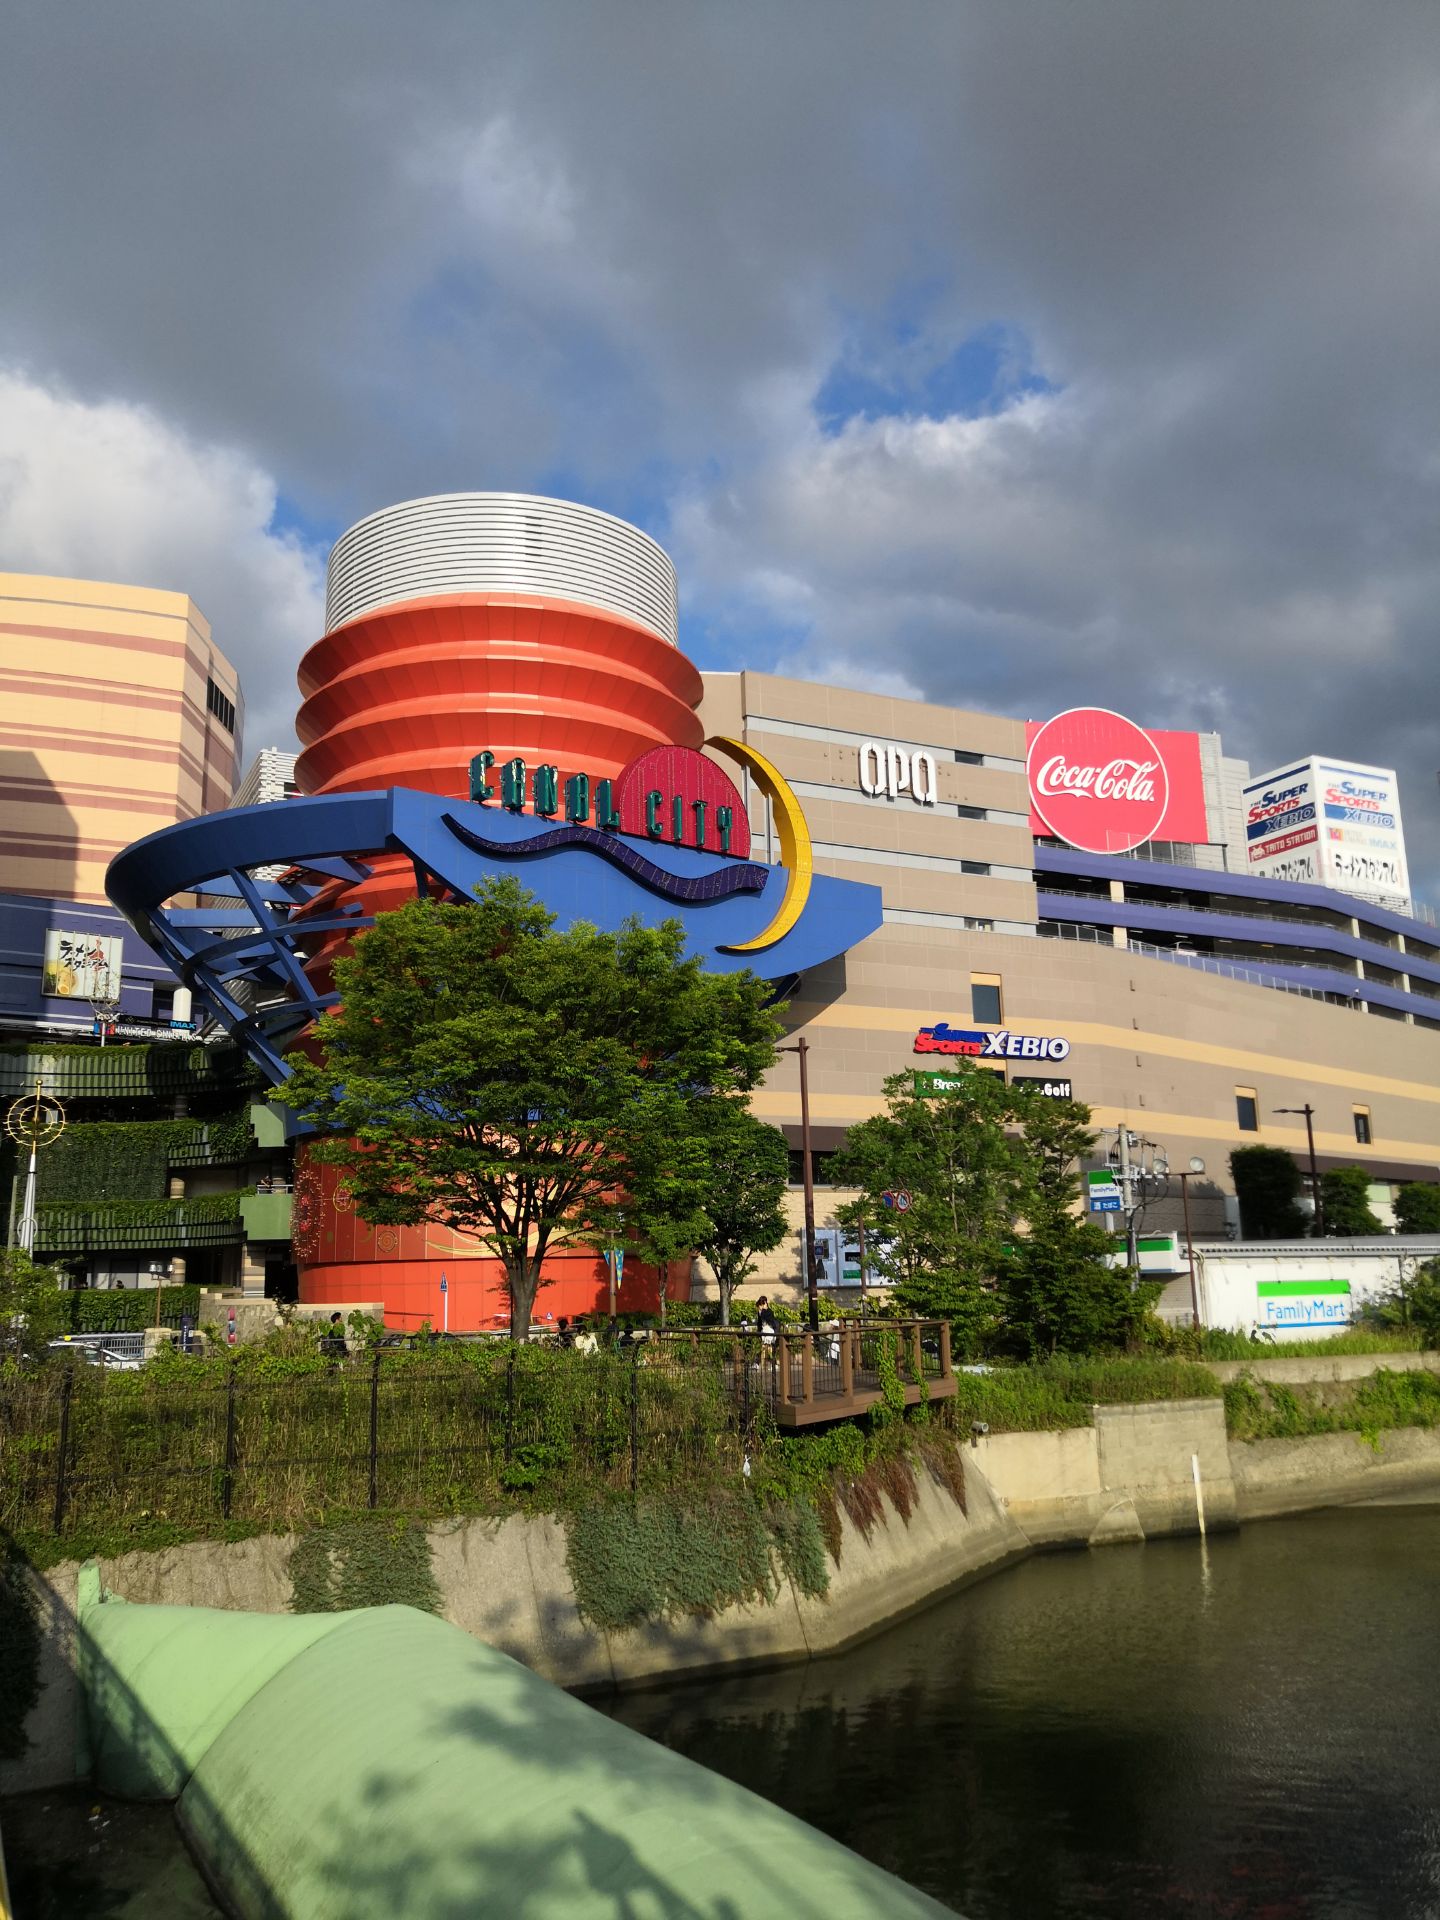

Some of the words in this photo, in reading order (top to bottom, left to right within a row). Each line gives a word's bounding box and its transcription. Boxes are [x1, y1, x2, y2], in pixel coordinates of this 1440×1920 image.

[1036, 755, 1159, 802] Coca-Cola
[1340, 781, 1387, 801] SUPER
[469, 751, 620, 831] CANAL
[646, 789, 733, 850] CITY
[1261, 783, 1308, 808] SUPER
[1325, 788, 1380, 811] SPORTS
[1248, 797, 1300, 824] SPORTS
[1264, 806, 1315, 835] XEBIO
[170, 1021, 197, 1029] IMAX
[984, 1031, 1070, 1060] XEBIO
[1044, 1083, 1070, 1097] Golf
[1266, 1300, 1345, 1324] FamilyMart
